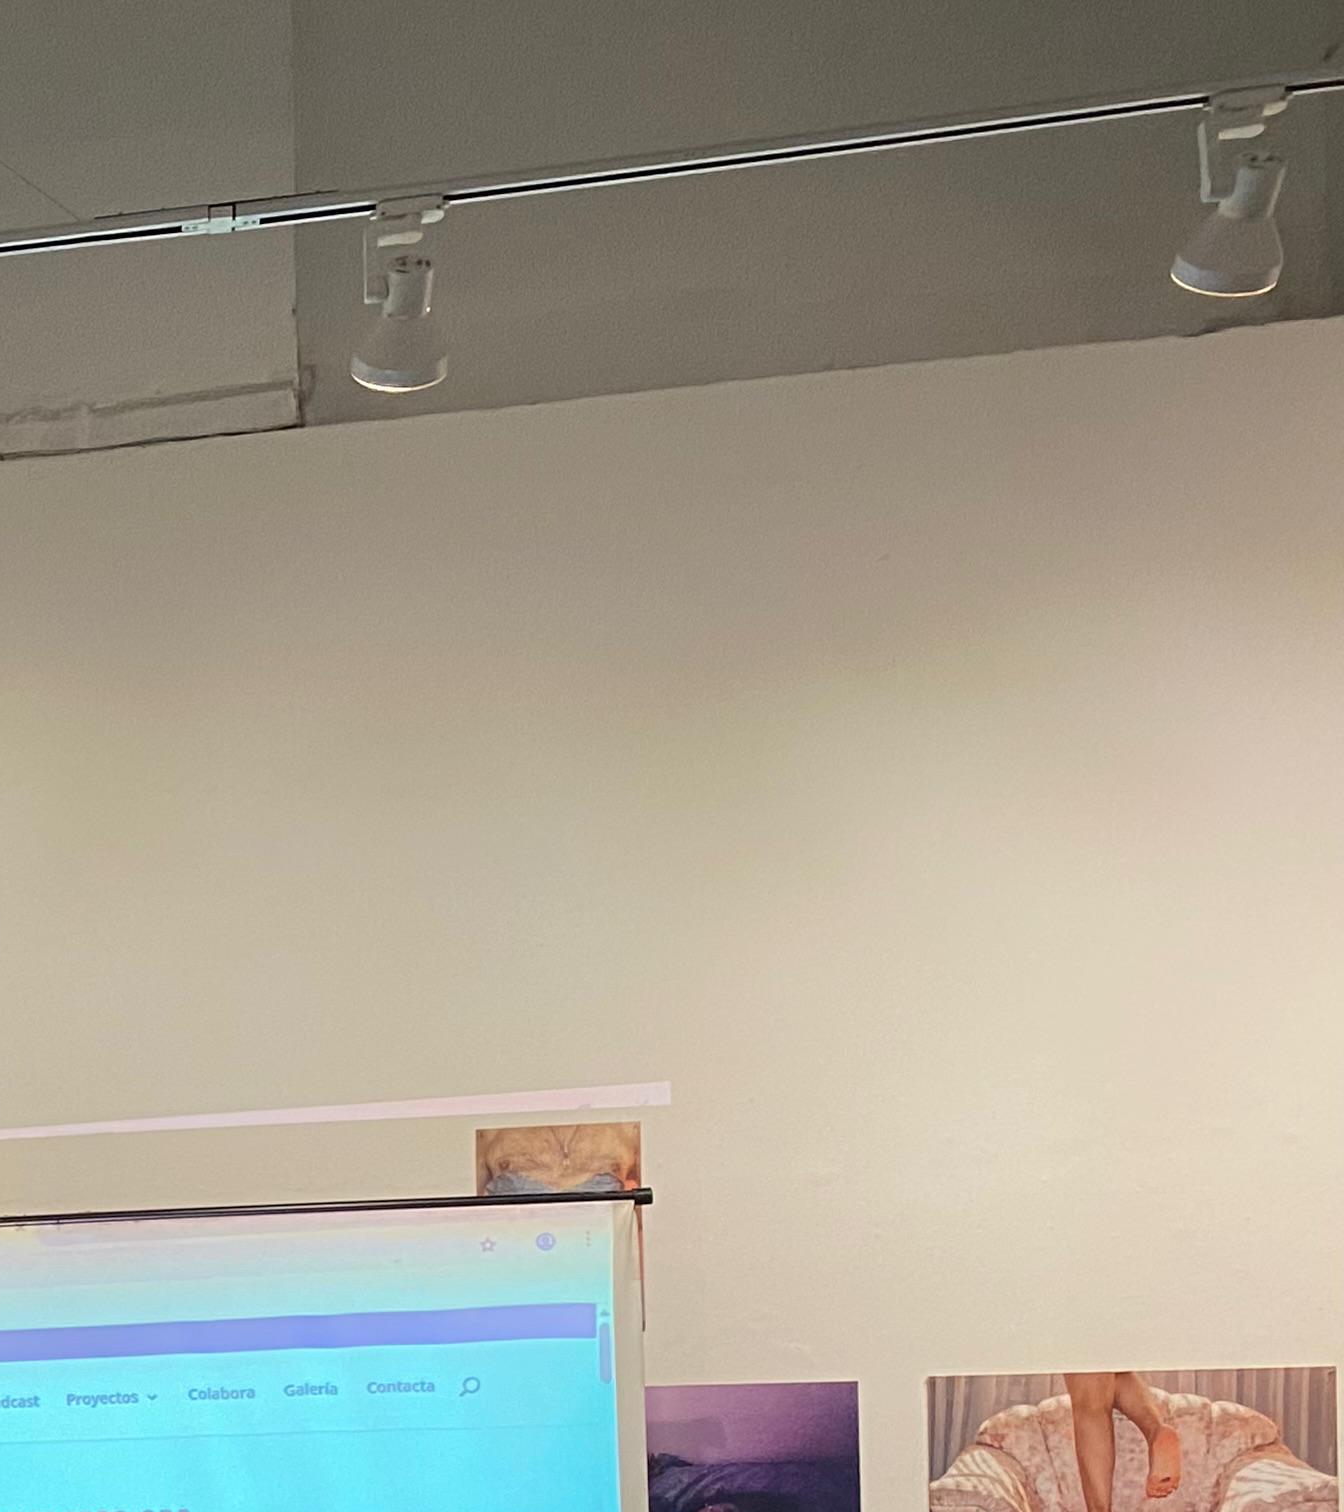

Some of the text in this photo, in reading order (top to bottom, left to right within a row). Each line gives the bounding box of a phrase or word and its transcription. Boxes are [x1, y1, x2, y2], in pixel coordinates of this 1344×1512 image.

[188, 1387, 256, 1400] Colabora
[284, 1382, 338, 1397] Galería
[367, 1381, 435, 1394] Contacta
[66, 1392, 139, 1408] Proyectos
